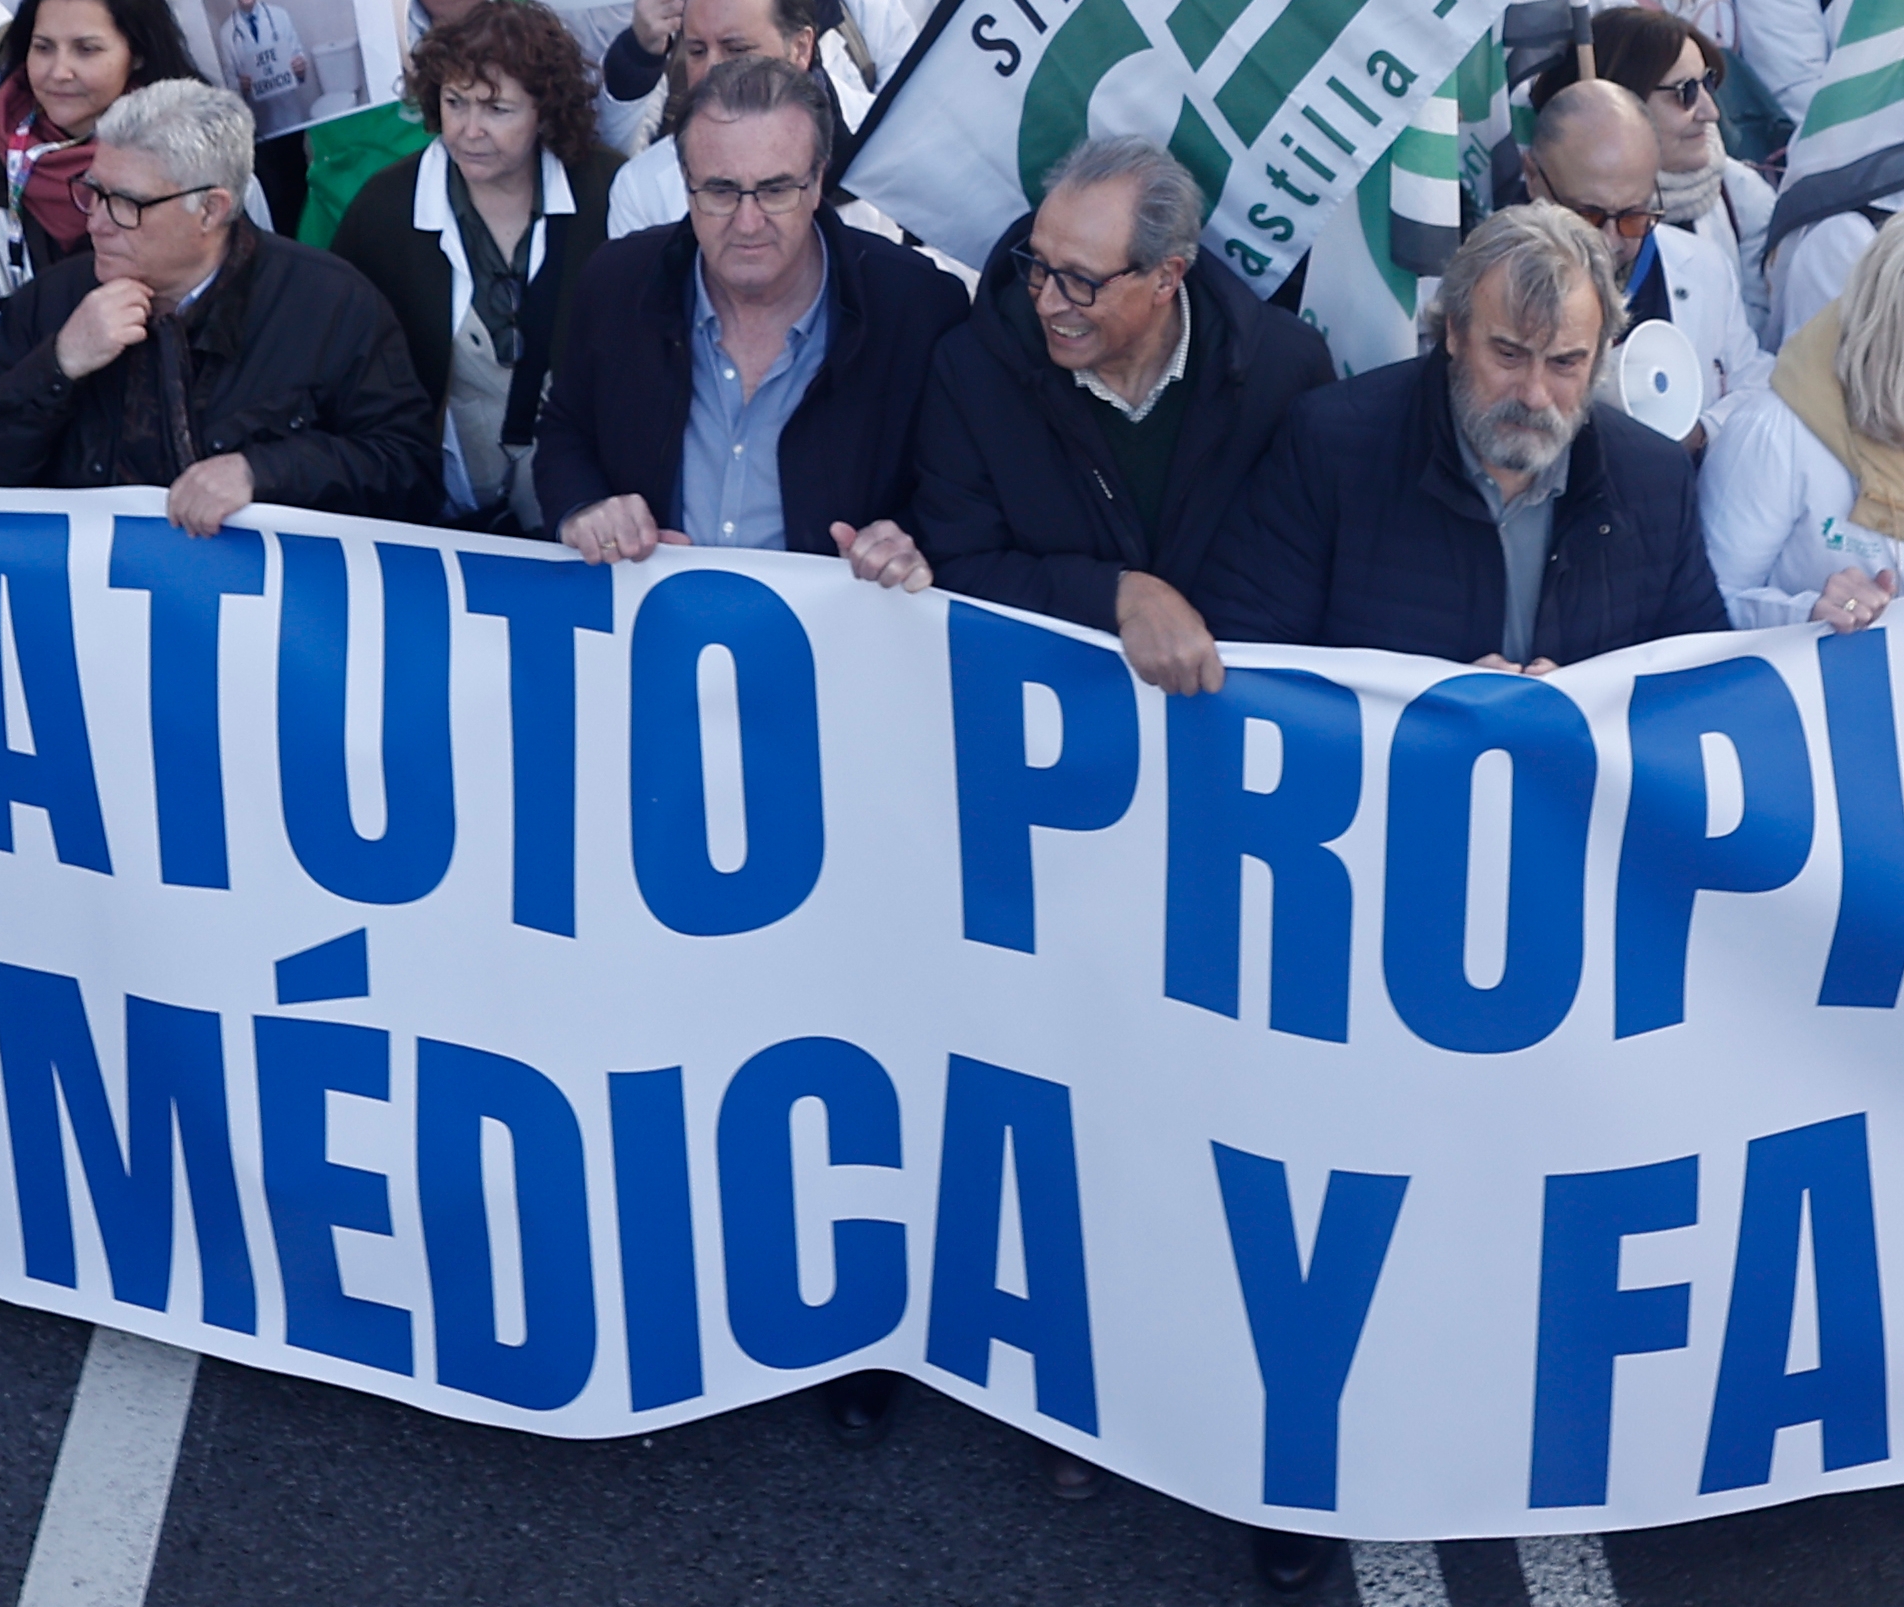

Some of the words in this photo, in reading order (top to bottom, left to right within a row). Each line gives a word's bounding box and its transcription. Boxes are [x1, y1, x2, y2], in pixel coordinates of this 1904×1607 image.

[253, 70, 293, 94] SERVICIO
[256, 47, 278, 68] JEFE
[1223, 49, 1420, 277] astilla
[1210, 1138, 1413, 1513] Y
